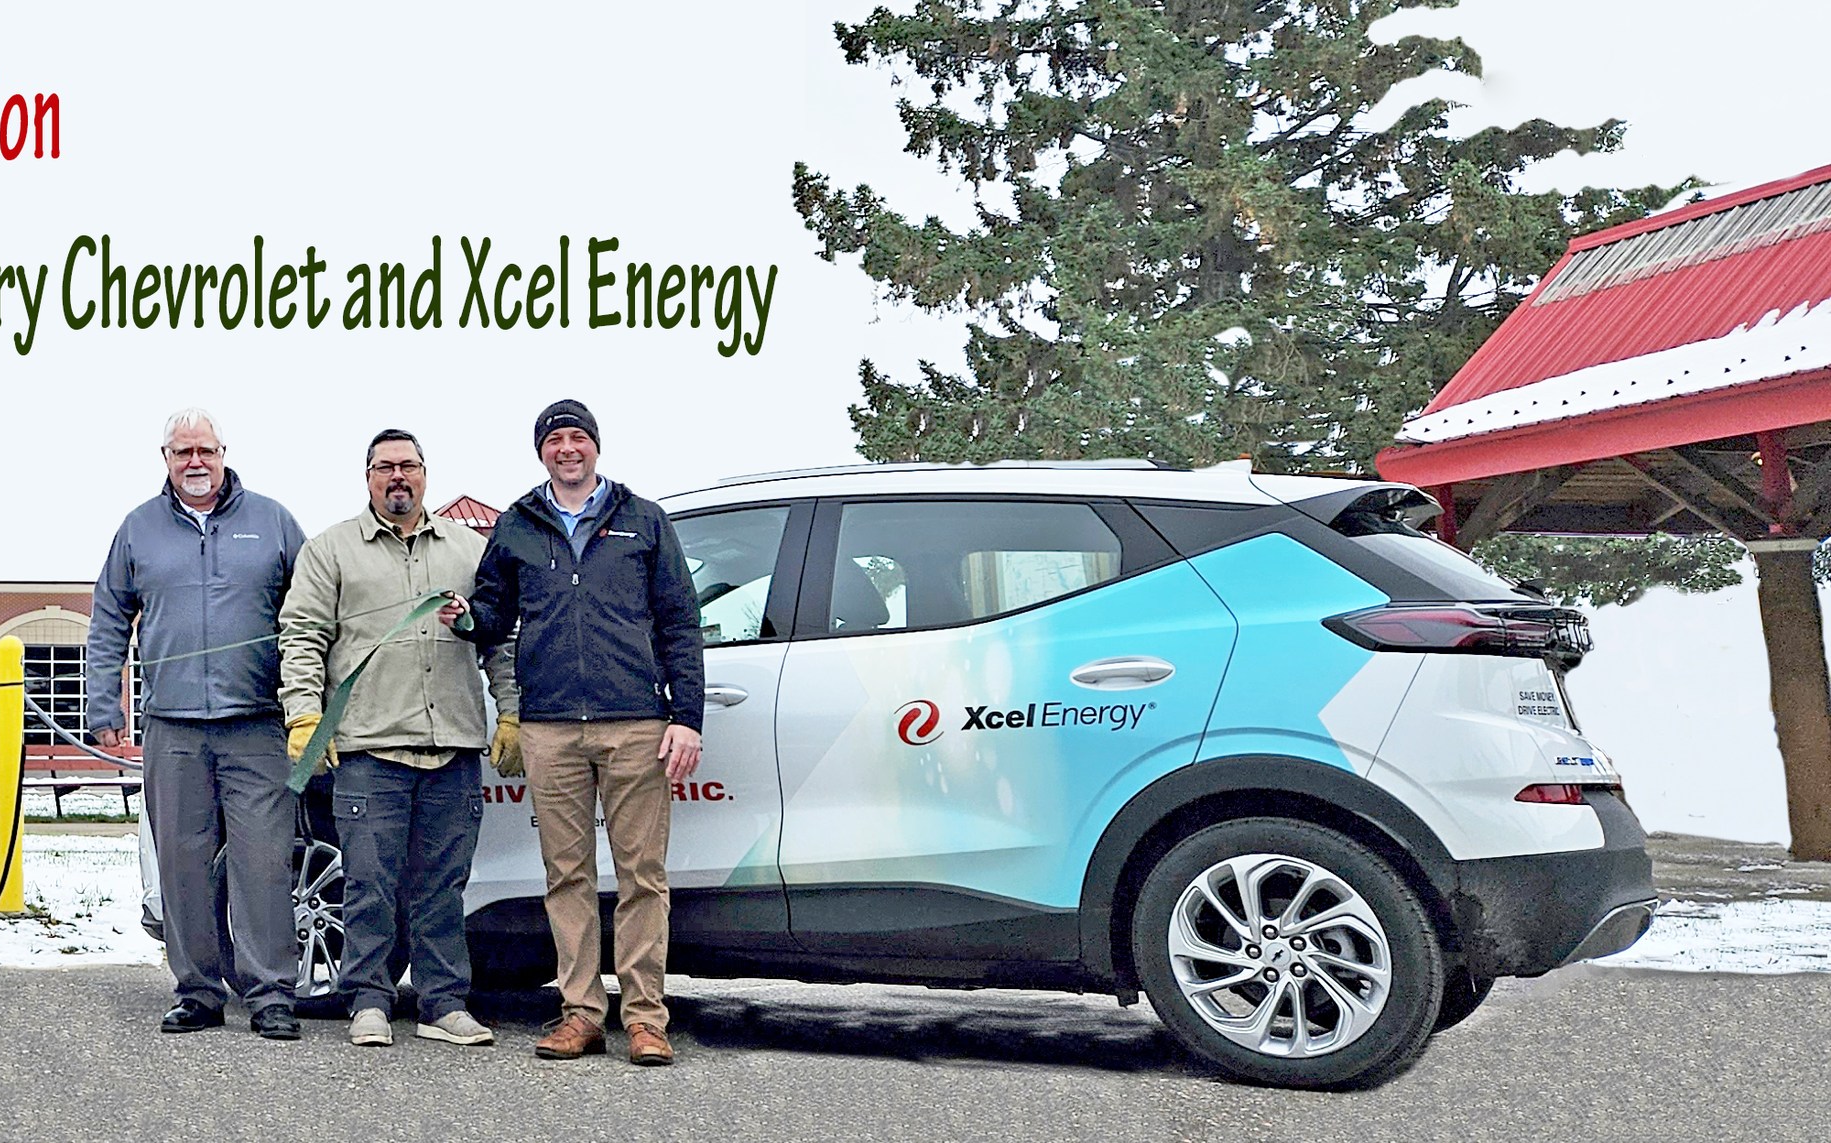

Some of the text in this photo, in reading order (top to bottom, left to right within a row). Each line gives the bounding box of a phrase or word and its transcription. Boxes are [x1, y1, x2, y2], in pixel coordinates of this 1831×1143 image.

[1519, 691, 1536, 701] SAVE
[1518, 705, 1560, 716] DRIVE ELECTRIC
[961, 703, 1036, 731] Xcel
